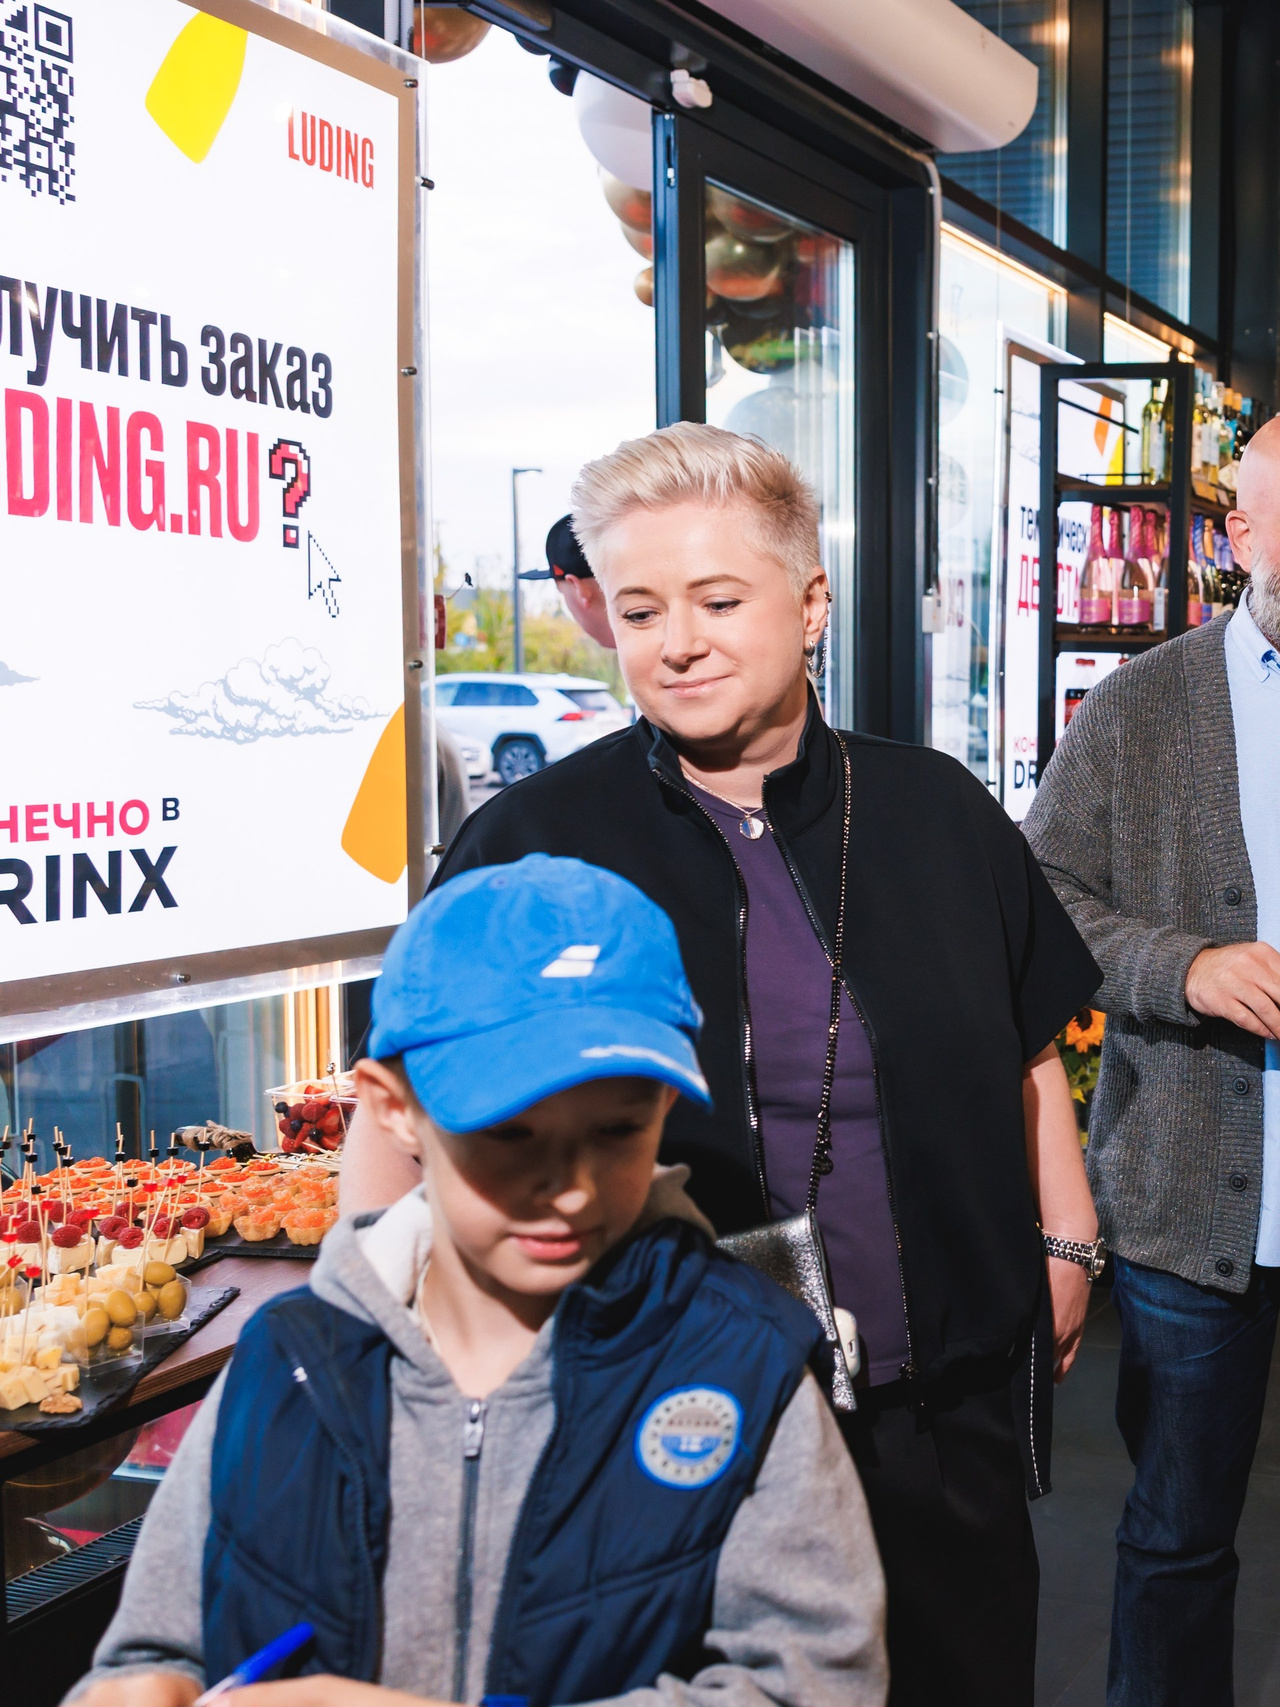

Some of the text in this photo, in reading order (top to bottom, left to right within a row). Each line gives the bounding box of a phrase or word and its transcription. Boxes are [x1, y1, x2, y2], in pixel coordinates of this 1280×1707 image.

[288, 104, 375, 190] LUDING
[0, 274, 333, 419] лучить заказ
[0, 799, 150, 844] НЕЧНО
[0, 845, 179, 926] RINX
